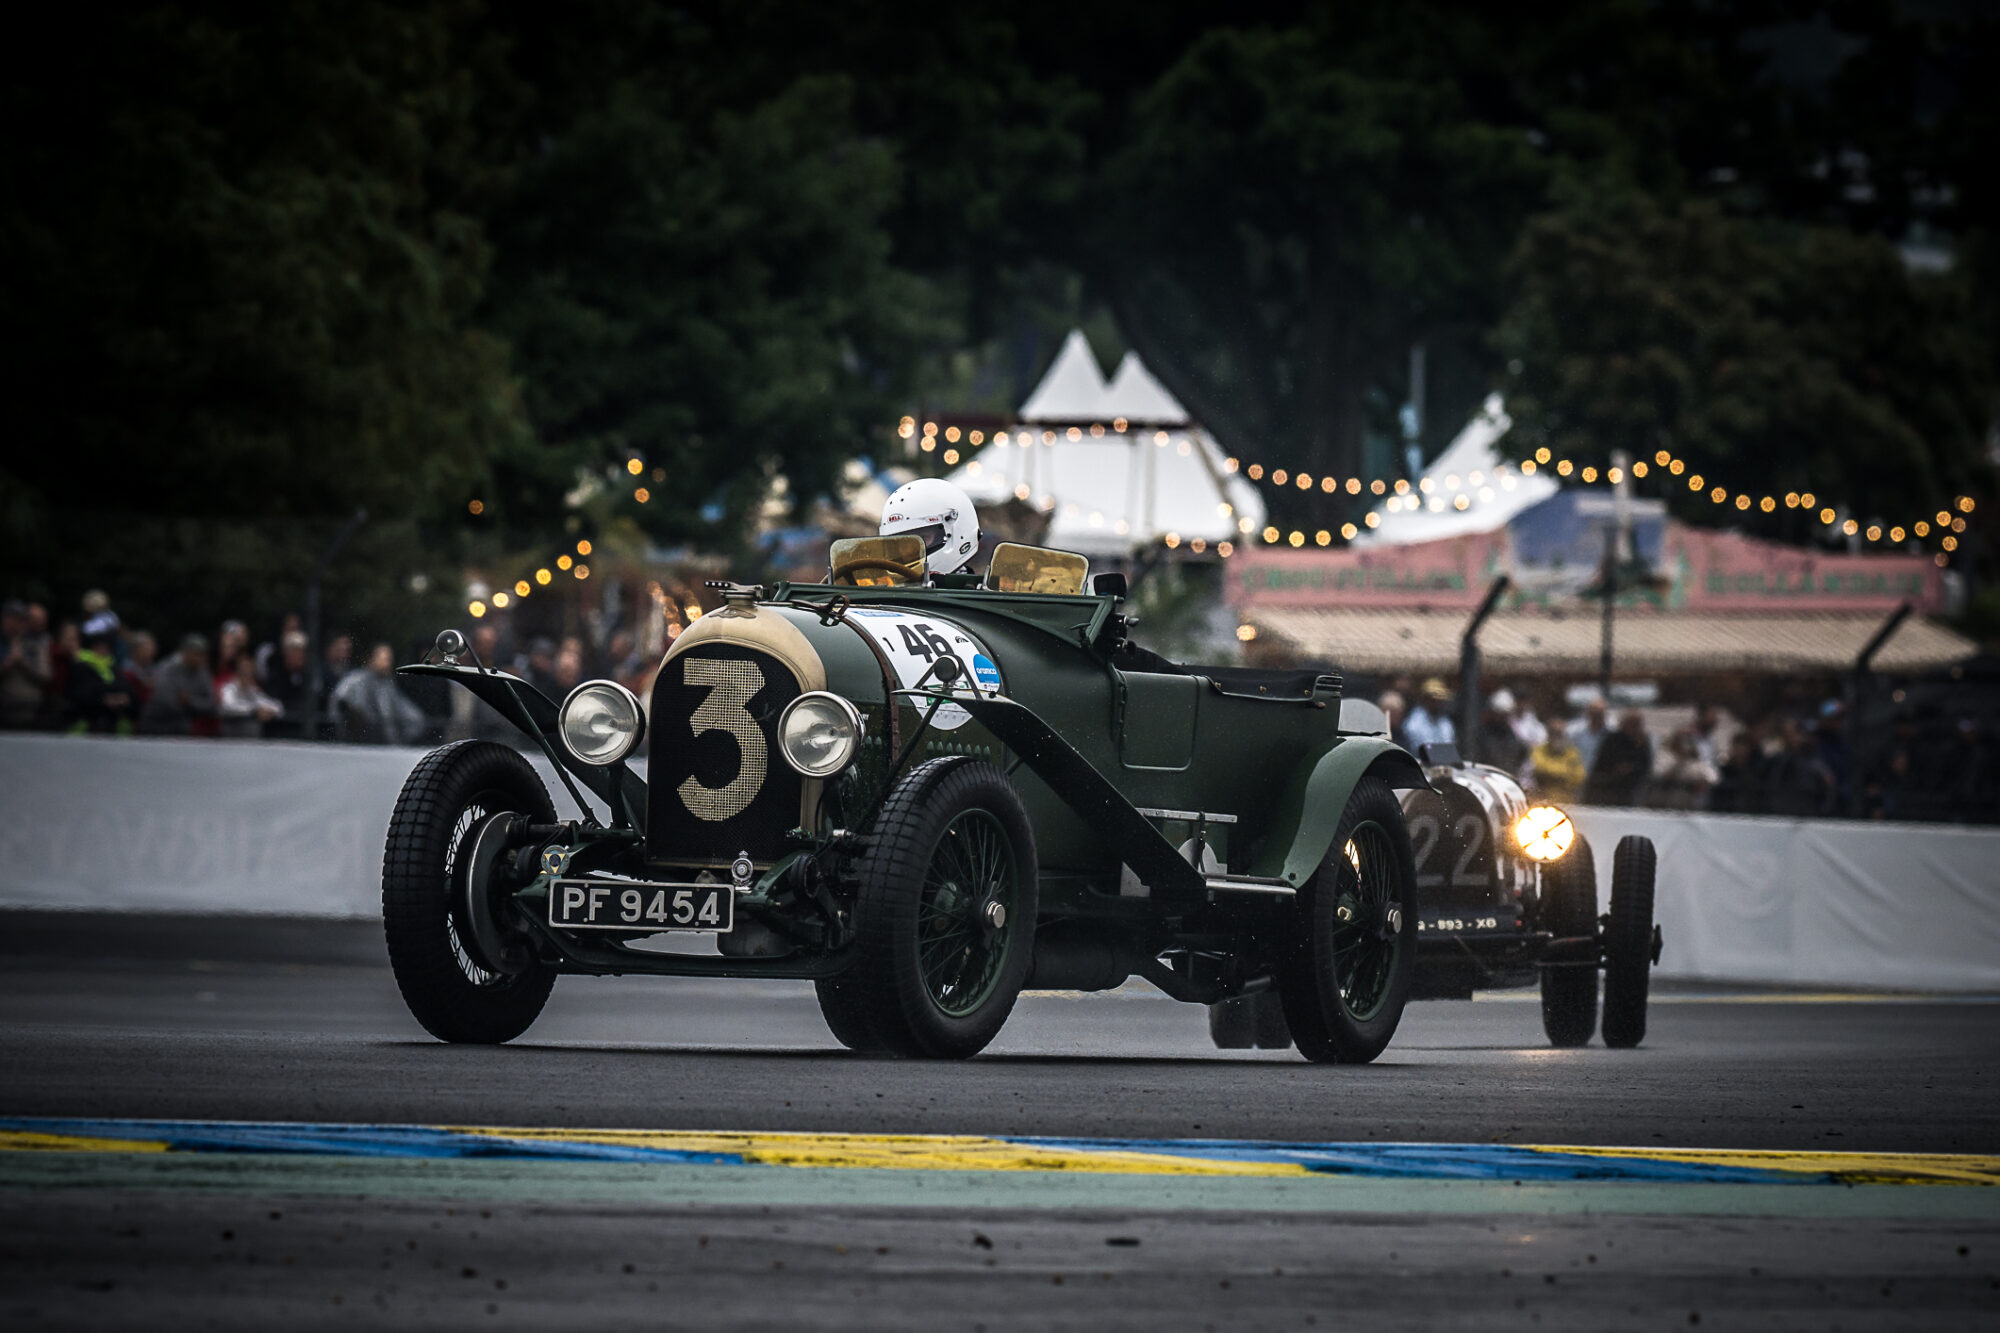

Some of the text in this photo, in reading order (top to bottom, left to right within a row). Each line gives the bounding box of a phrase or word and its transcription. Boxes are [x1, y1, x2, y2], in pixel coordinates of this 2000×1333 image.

[896, 624, 954, 663] 46
[677, 657, 768, 822] 3
[1408, 815, 1489, 886] 22
[563, 887, 720, 925] PF 9454
